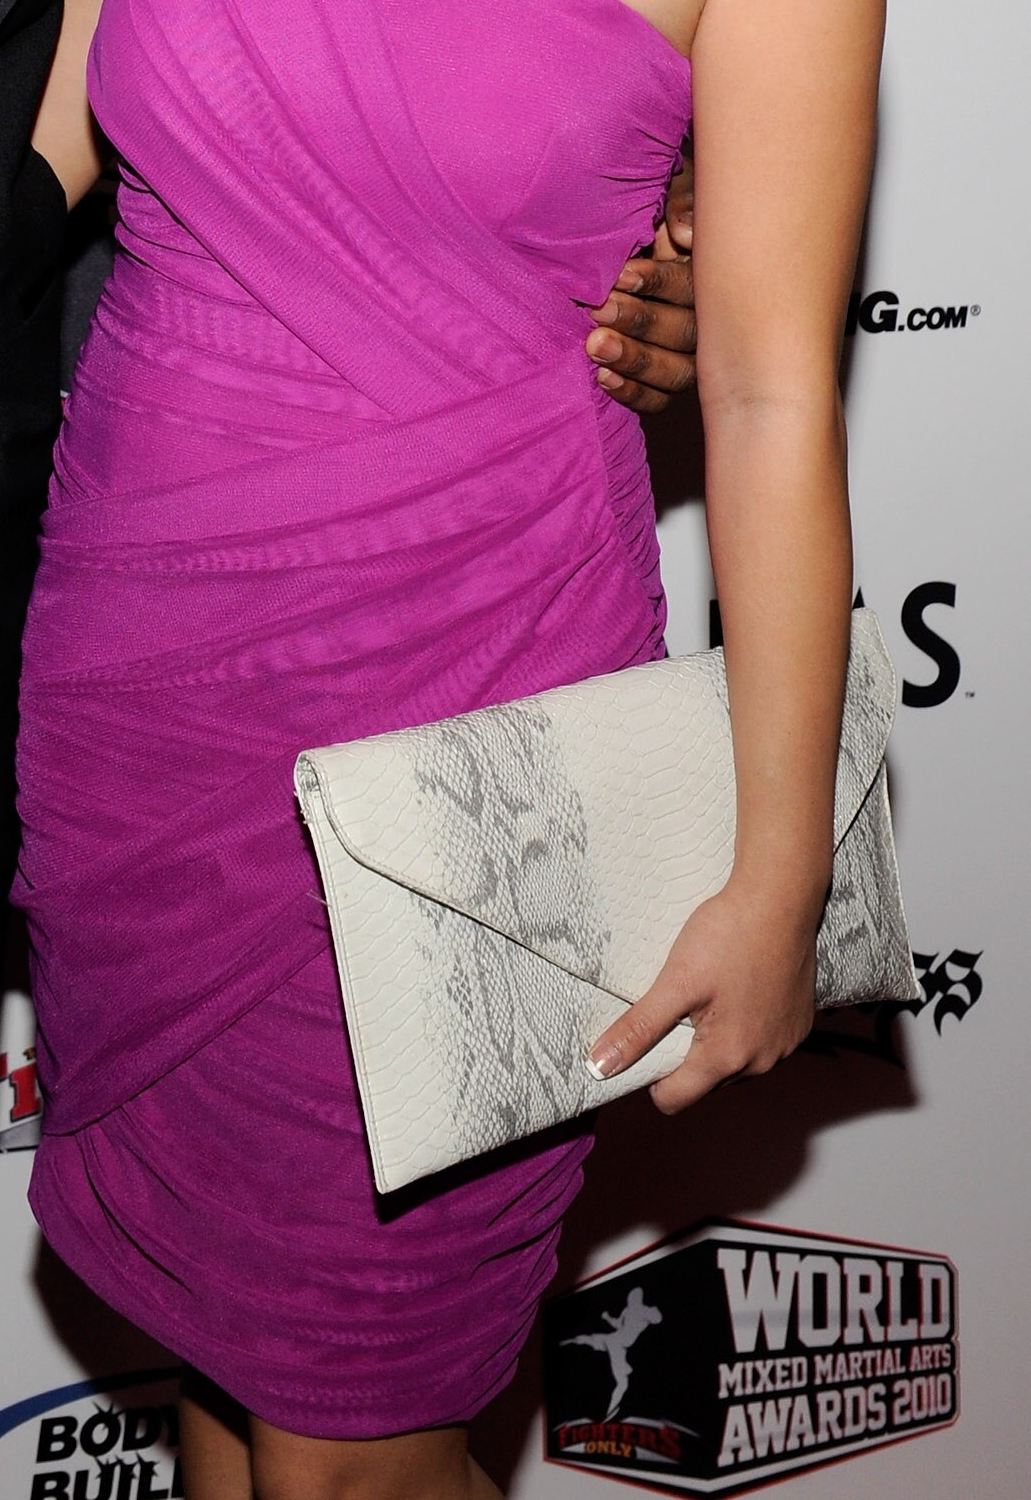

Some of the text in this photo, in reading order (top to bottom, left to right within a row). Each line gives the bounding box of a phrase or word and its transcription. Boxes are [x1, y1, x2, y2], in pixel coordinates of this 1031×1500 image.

[717, 1248, 952, 1353] WORLD
[718, 1341, 952, 1399] MIXED MARTIAL ARTS
[586, 1440, 632, 1458] ONLY
[717, 1373, 952, 1468] AWARDS 2010
